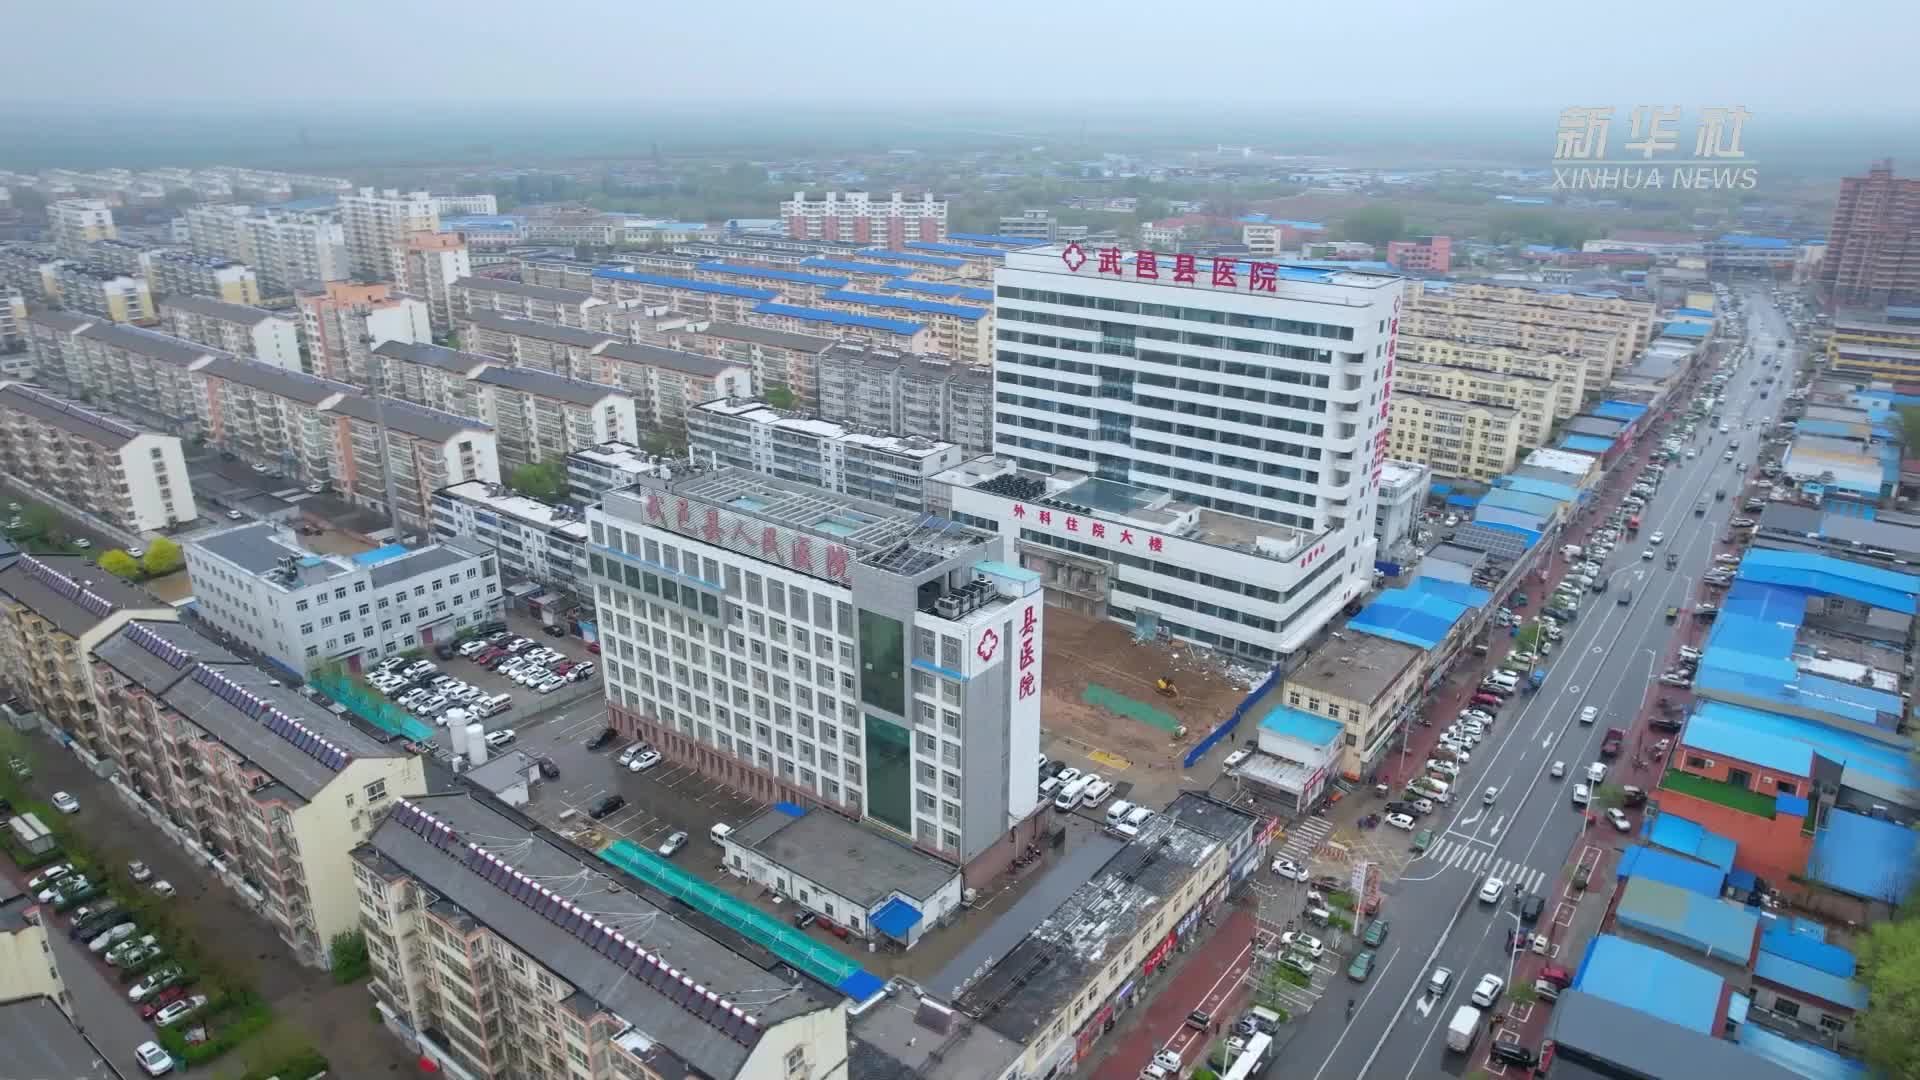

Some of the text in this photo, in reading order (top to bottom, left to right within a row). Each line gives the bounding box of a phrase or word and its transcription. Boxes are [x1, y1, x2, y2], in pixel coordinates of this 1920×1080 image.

[1098, 246, 1279, 293] 武邑县医院
[1013, 503, 1164, 553] 外科住院大楼
[1019, 605, 1038, 701] 县医院
